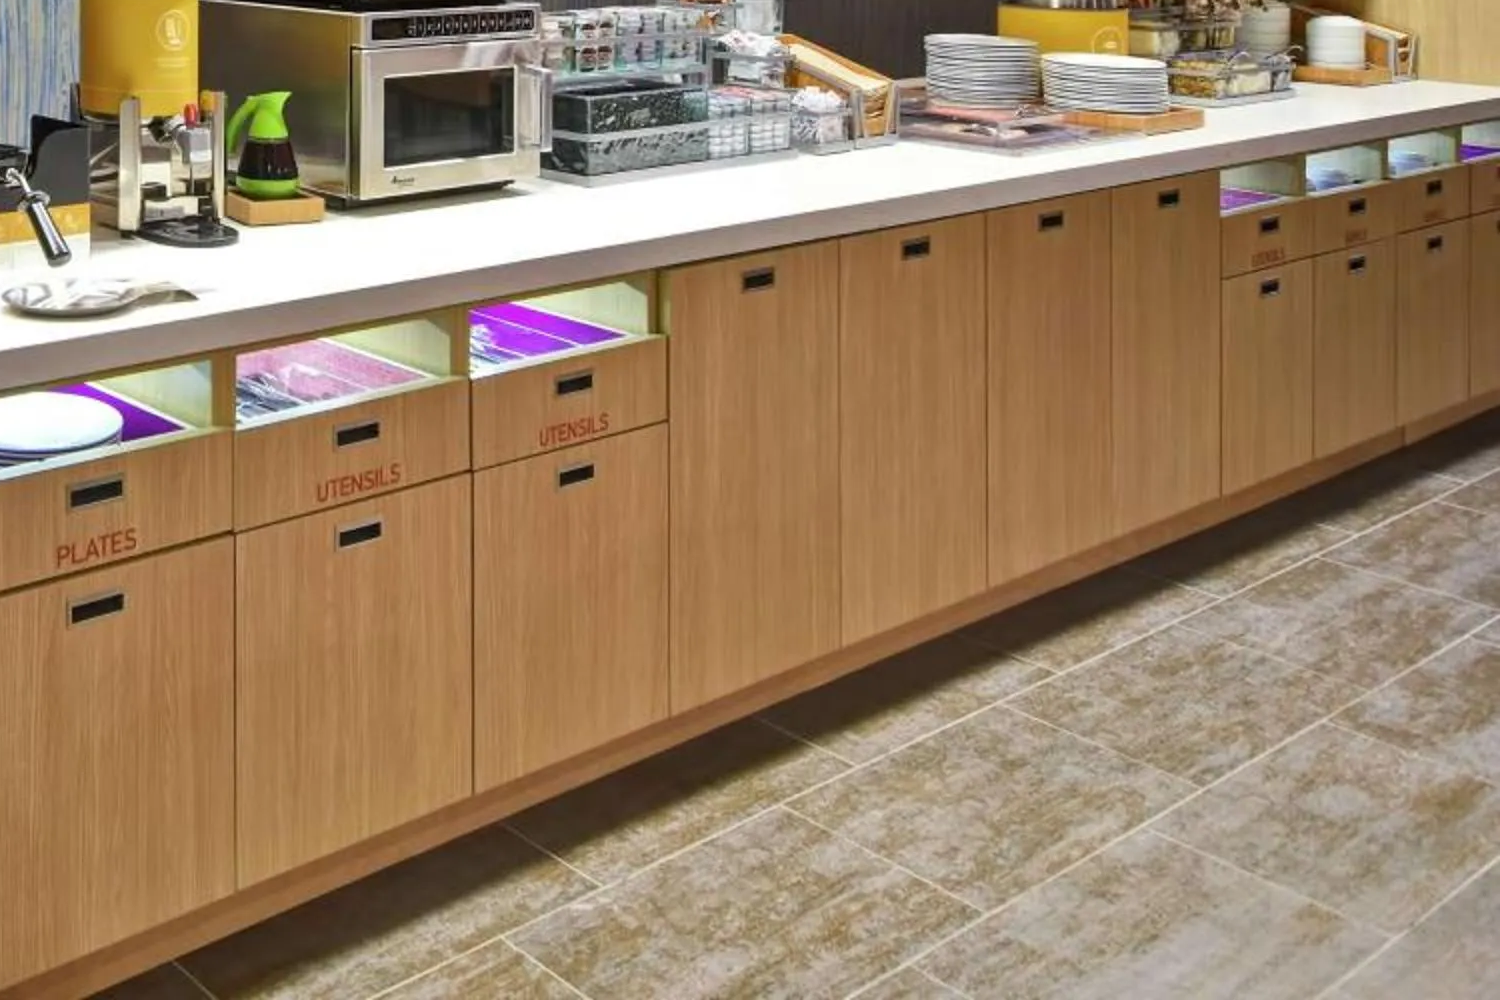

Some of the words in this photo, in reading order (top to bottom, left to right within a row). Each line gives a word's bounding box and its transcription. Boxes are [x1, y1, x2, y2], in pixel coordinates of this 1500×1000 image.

[539, 411, 609, 448] UTENSILS
[317, 462, 401, 503] UTENSILS
[56, 527, 137, 569] PLATES
